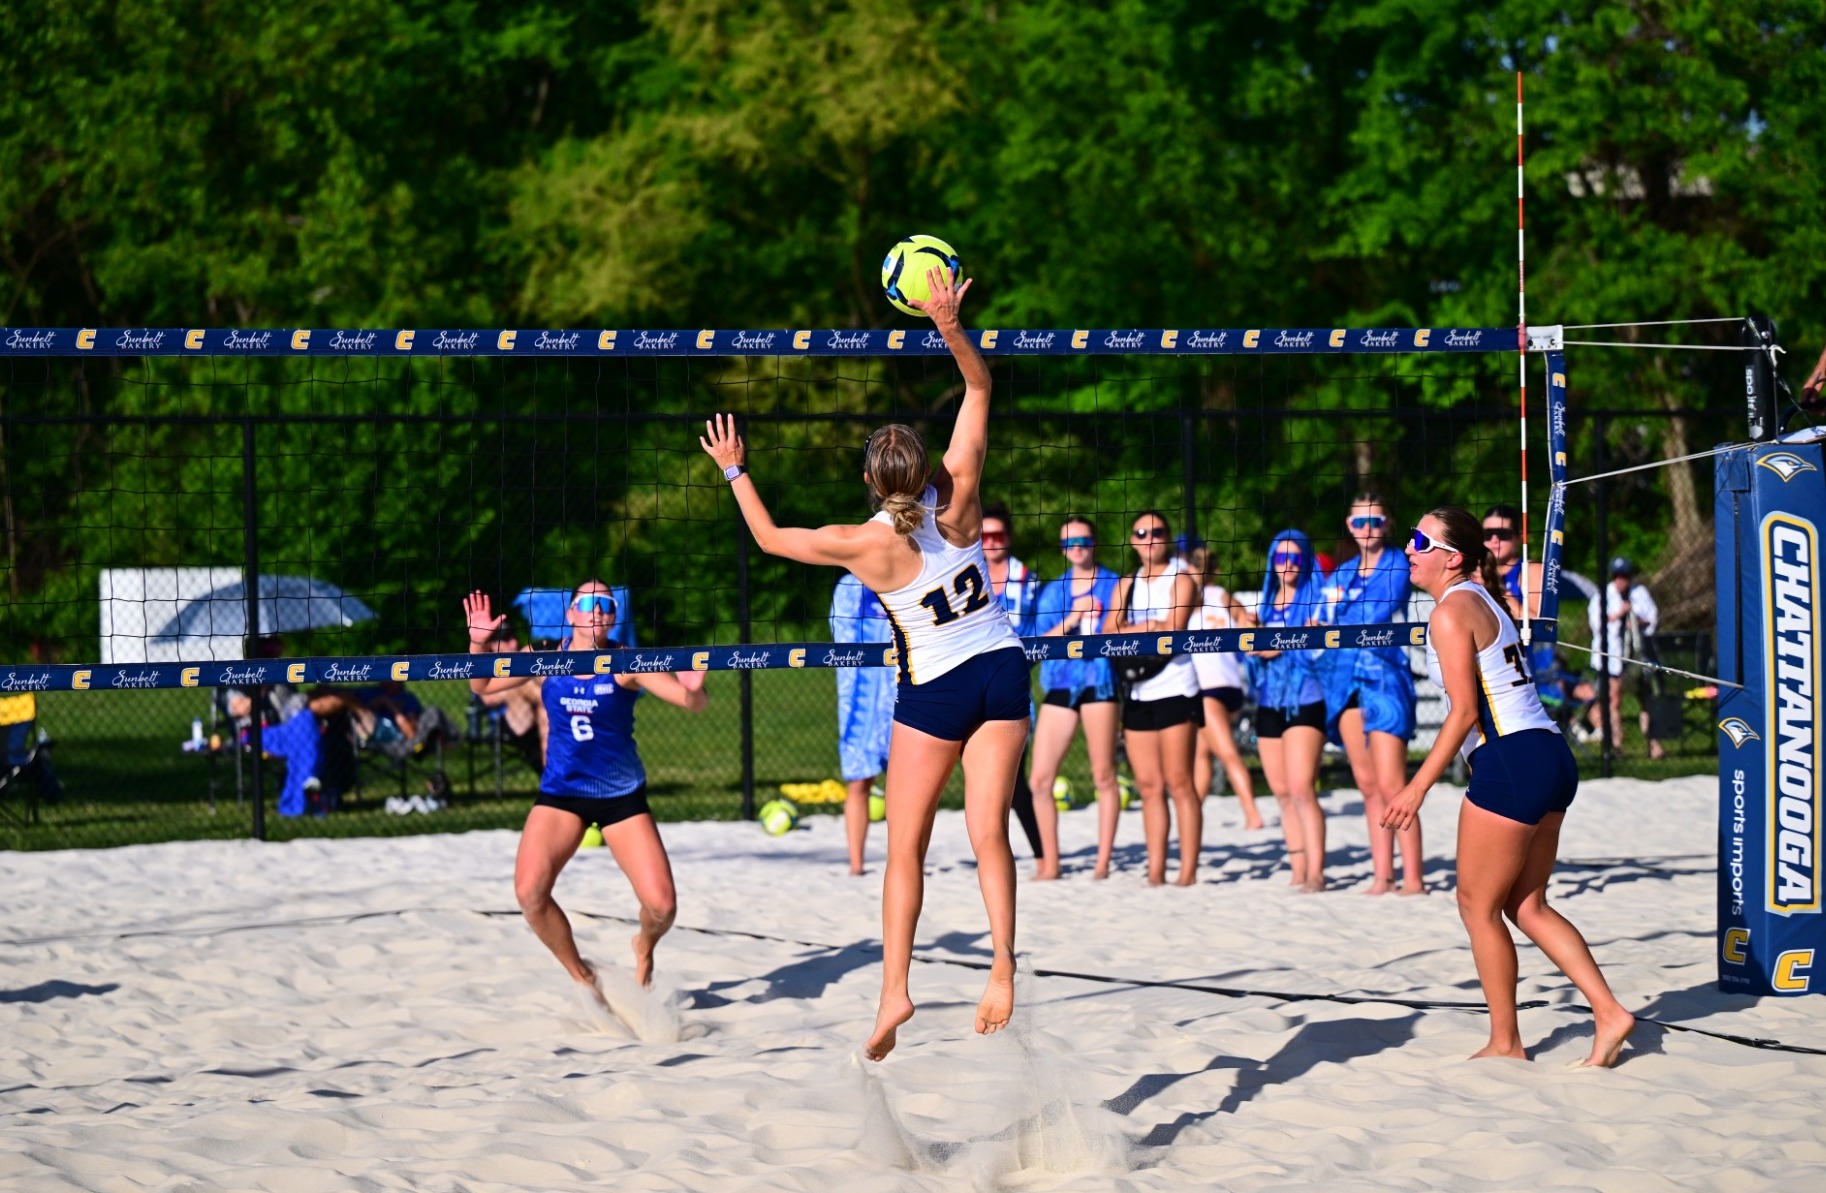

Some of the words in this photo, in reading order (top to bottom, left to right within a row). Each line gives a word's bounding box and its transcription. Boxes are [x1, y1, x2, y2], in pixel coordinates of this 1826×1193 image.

[6, 330, 56, 346] Sunbelt
[116, 330, 165, 345] Sunbelt
[223, 330, 272, 346] Sunbelt
[329, 330, 376, 345] Sunbelt
[432, 330, 479, 346] Sunbelt
[534, 330, 580, 345] Sunbelt
[633, 330, 679, 345] Sunbelt
[731, 330, 776, 345] Sunbelt
[827, 330, 871, 345] Sunbelt
[1013, 330, 1055, 344] Sunbelt
[1104, 330, 1146, 344] Sunbelt
[1187, 330, 1228, 344] Sunbelt
[1274, 330, 1314, 344] Sunbelt
[1360, 330, 1400, 343] Sunbelt
[1445, 330, 1483, 342] Sunbelt
[12, 342, 54, 350] BAKERY
[229, 342, 270, 350] BAKERY
[438, 342, 477, 350] BAKERY
[918, 562, 990, 627] 12
[1183, 636, 1222, 649] Sunbelt
[1270, 633, 1309, 646] Sunbelt
[1356, 630, 1395, 643] Sunbelt
[1024, 644, 1051, 654] nbelt
[1101, 640, 1140, 653] Sunbelt
[630, 654, 674, 668] Sunbelt
[728, 651, 771, 665] Sunbelt
[823, 648, 866, 662] Sunbelt
[325, 663, 371, 678] Sunbelt
[429, 660, 474, 675] Sunbelt
[530, 657, 576, 672] Sunbelt
[112, 670, 160, 685] Sunbelt
[219, 666, 266, 682] Sunbelt
[331, 674, 369, 682] BAKERY
[536, 668, 574, 676] BAKERY
[2, 672, 51, 688] Sunbelt
[118, 681, 158, 689] BAKERY
[225, 678, 264, 686] BAKERY
[560, 697, 598, 707] GEORGIA
[566, 704, 593, 714] STATE
[1773, 526, 1813, 902] CHATTANOOGA
[570, 715, 594, 742] 6
[1732, 769, 1746, 833] sports
[1730, 837, 1745, 916] imports
